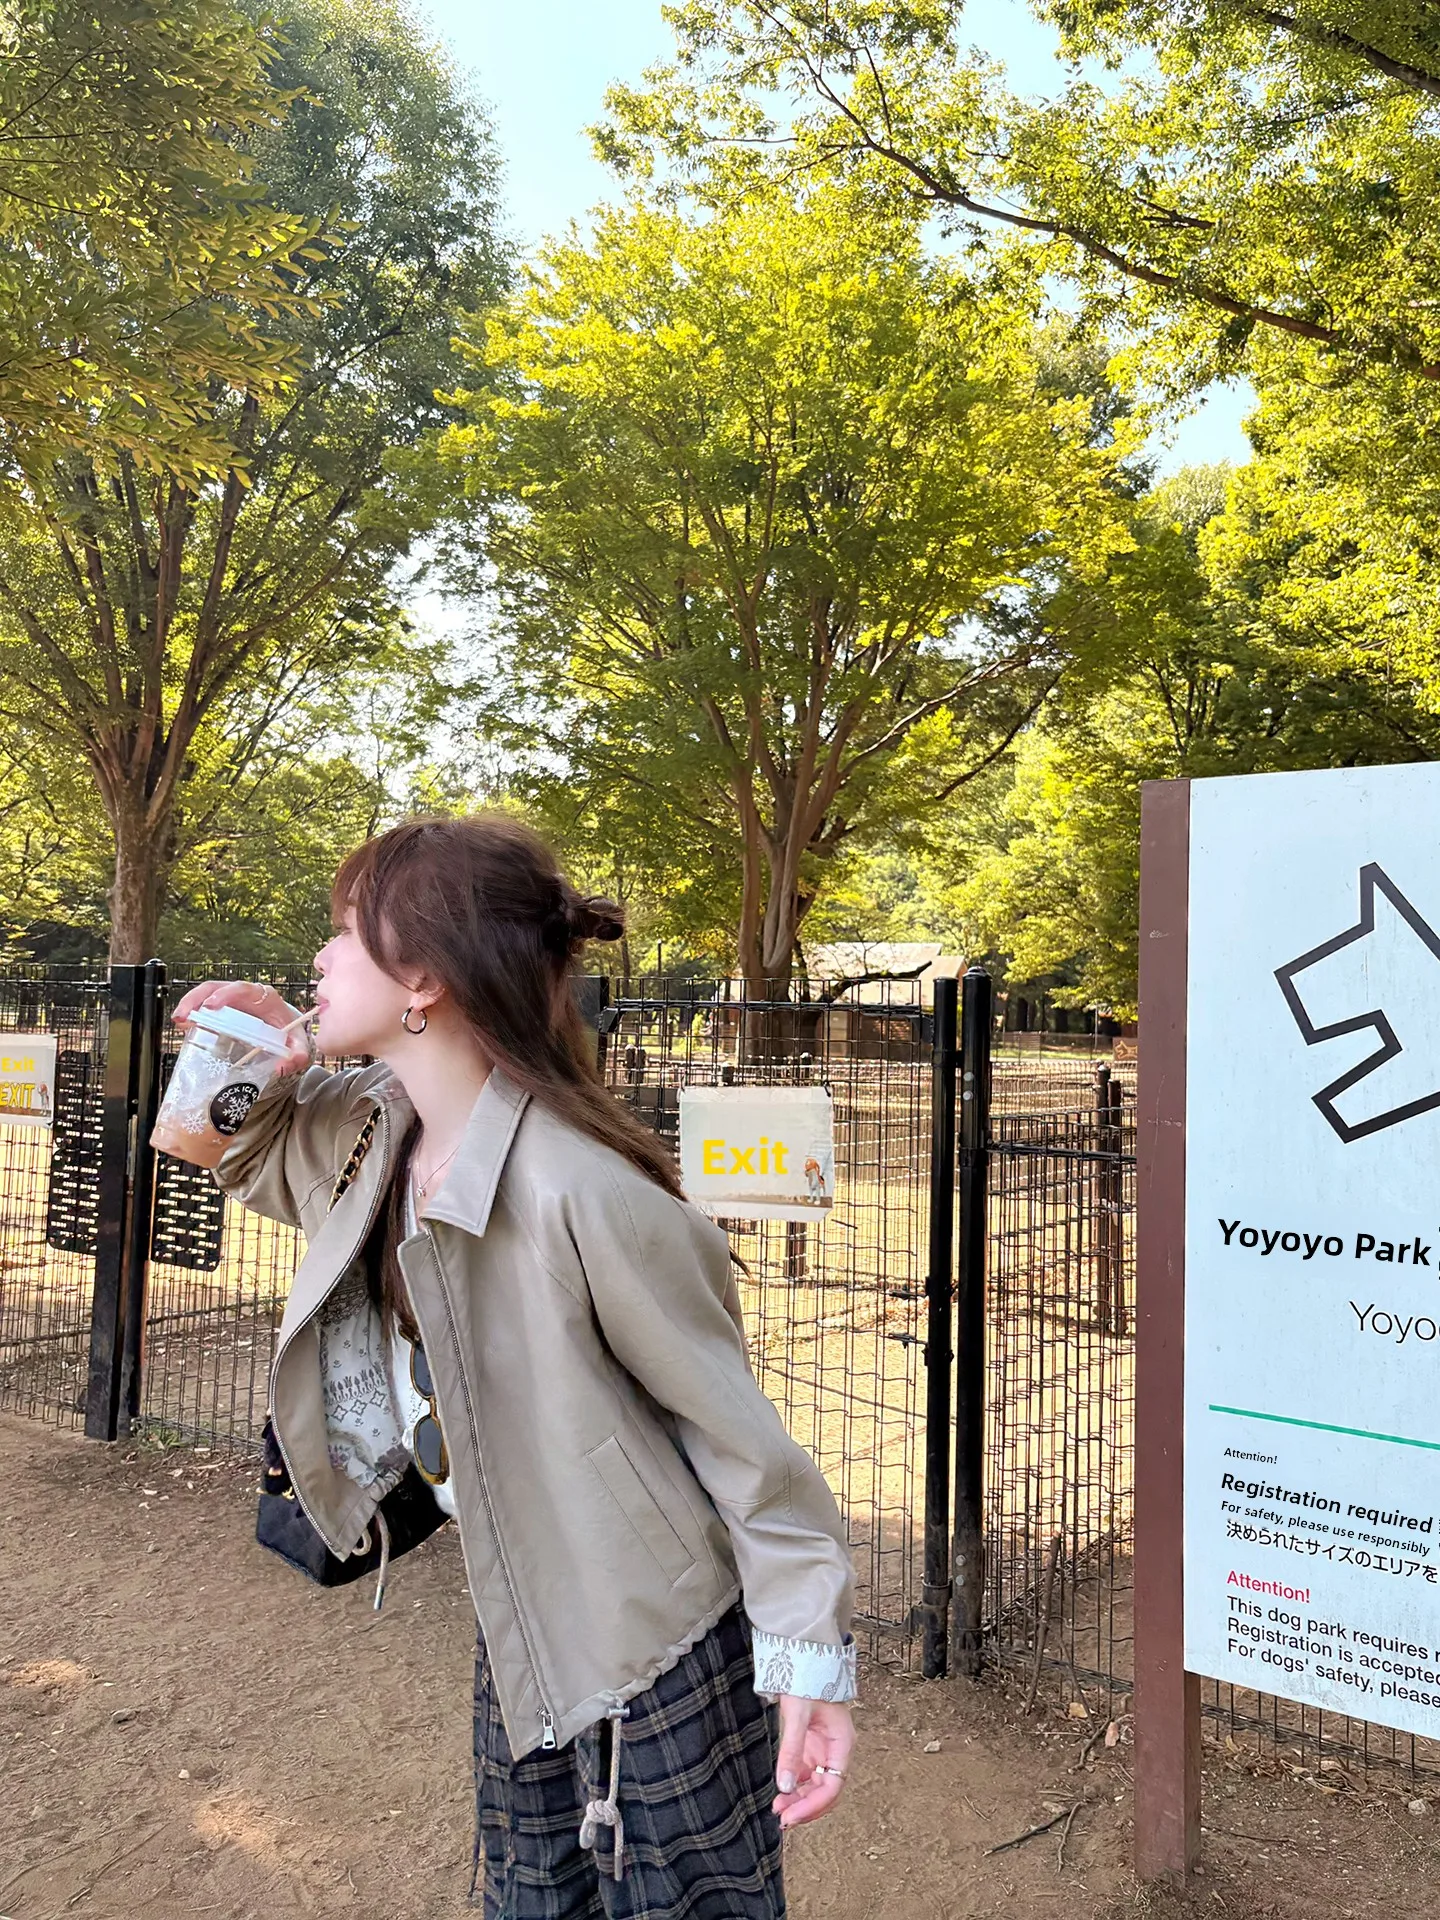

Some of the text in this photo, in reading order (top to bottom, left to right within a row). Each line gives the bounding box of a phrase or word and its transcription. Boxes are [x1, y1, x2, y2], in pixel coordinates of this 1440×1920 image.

[1, 1056, 35, 1072] Exit
[0, 1082, 35, 1109] EXIT
[218, 1087, 240, 1103] ROCK
[703, 1137, 789, 1175] Exit
[1218, 1218, 1344, 1260] Yoyoyo
[1355, 1233, 1432, 1266] Park
[1349, 1301, 1440, 1344] Yoyo
[1224, 1447, 1278, 1464] Attention!
[1221, 1473, 1341, 1514] Registration
[1347, 1504, 1433, 1534] required
[1221, 1500, 1241, 1514] For
[1244, 1507, 1284, 1525] safety,
[1288, 1516, 1330, 1533] please
[1332, 1526, 1355, 1539] use
[1358, 1532, 1430, 1557] responsibly
[1226, 1518, 1438, 1584] 決められたサイズのエリアを
[1227, 1570, 1310, 1603] Attention!
[1227, 1595, 1262, 1618] This
[1268, 1607, 1301, 1631] dog
[1308, 1619, 1347, 1640] park
[1353, 1630, 1428, 1659] requires
[1228, 1617, 1332, 1658] Registration
[1339, 1645, 1353, 1663] is
[1228, 1638, 1440, 1708] For dogs' safety, please
